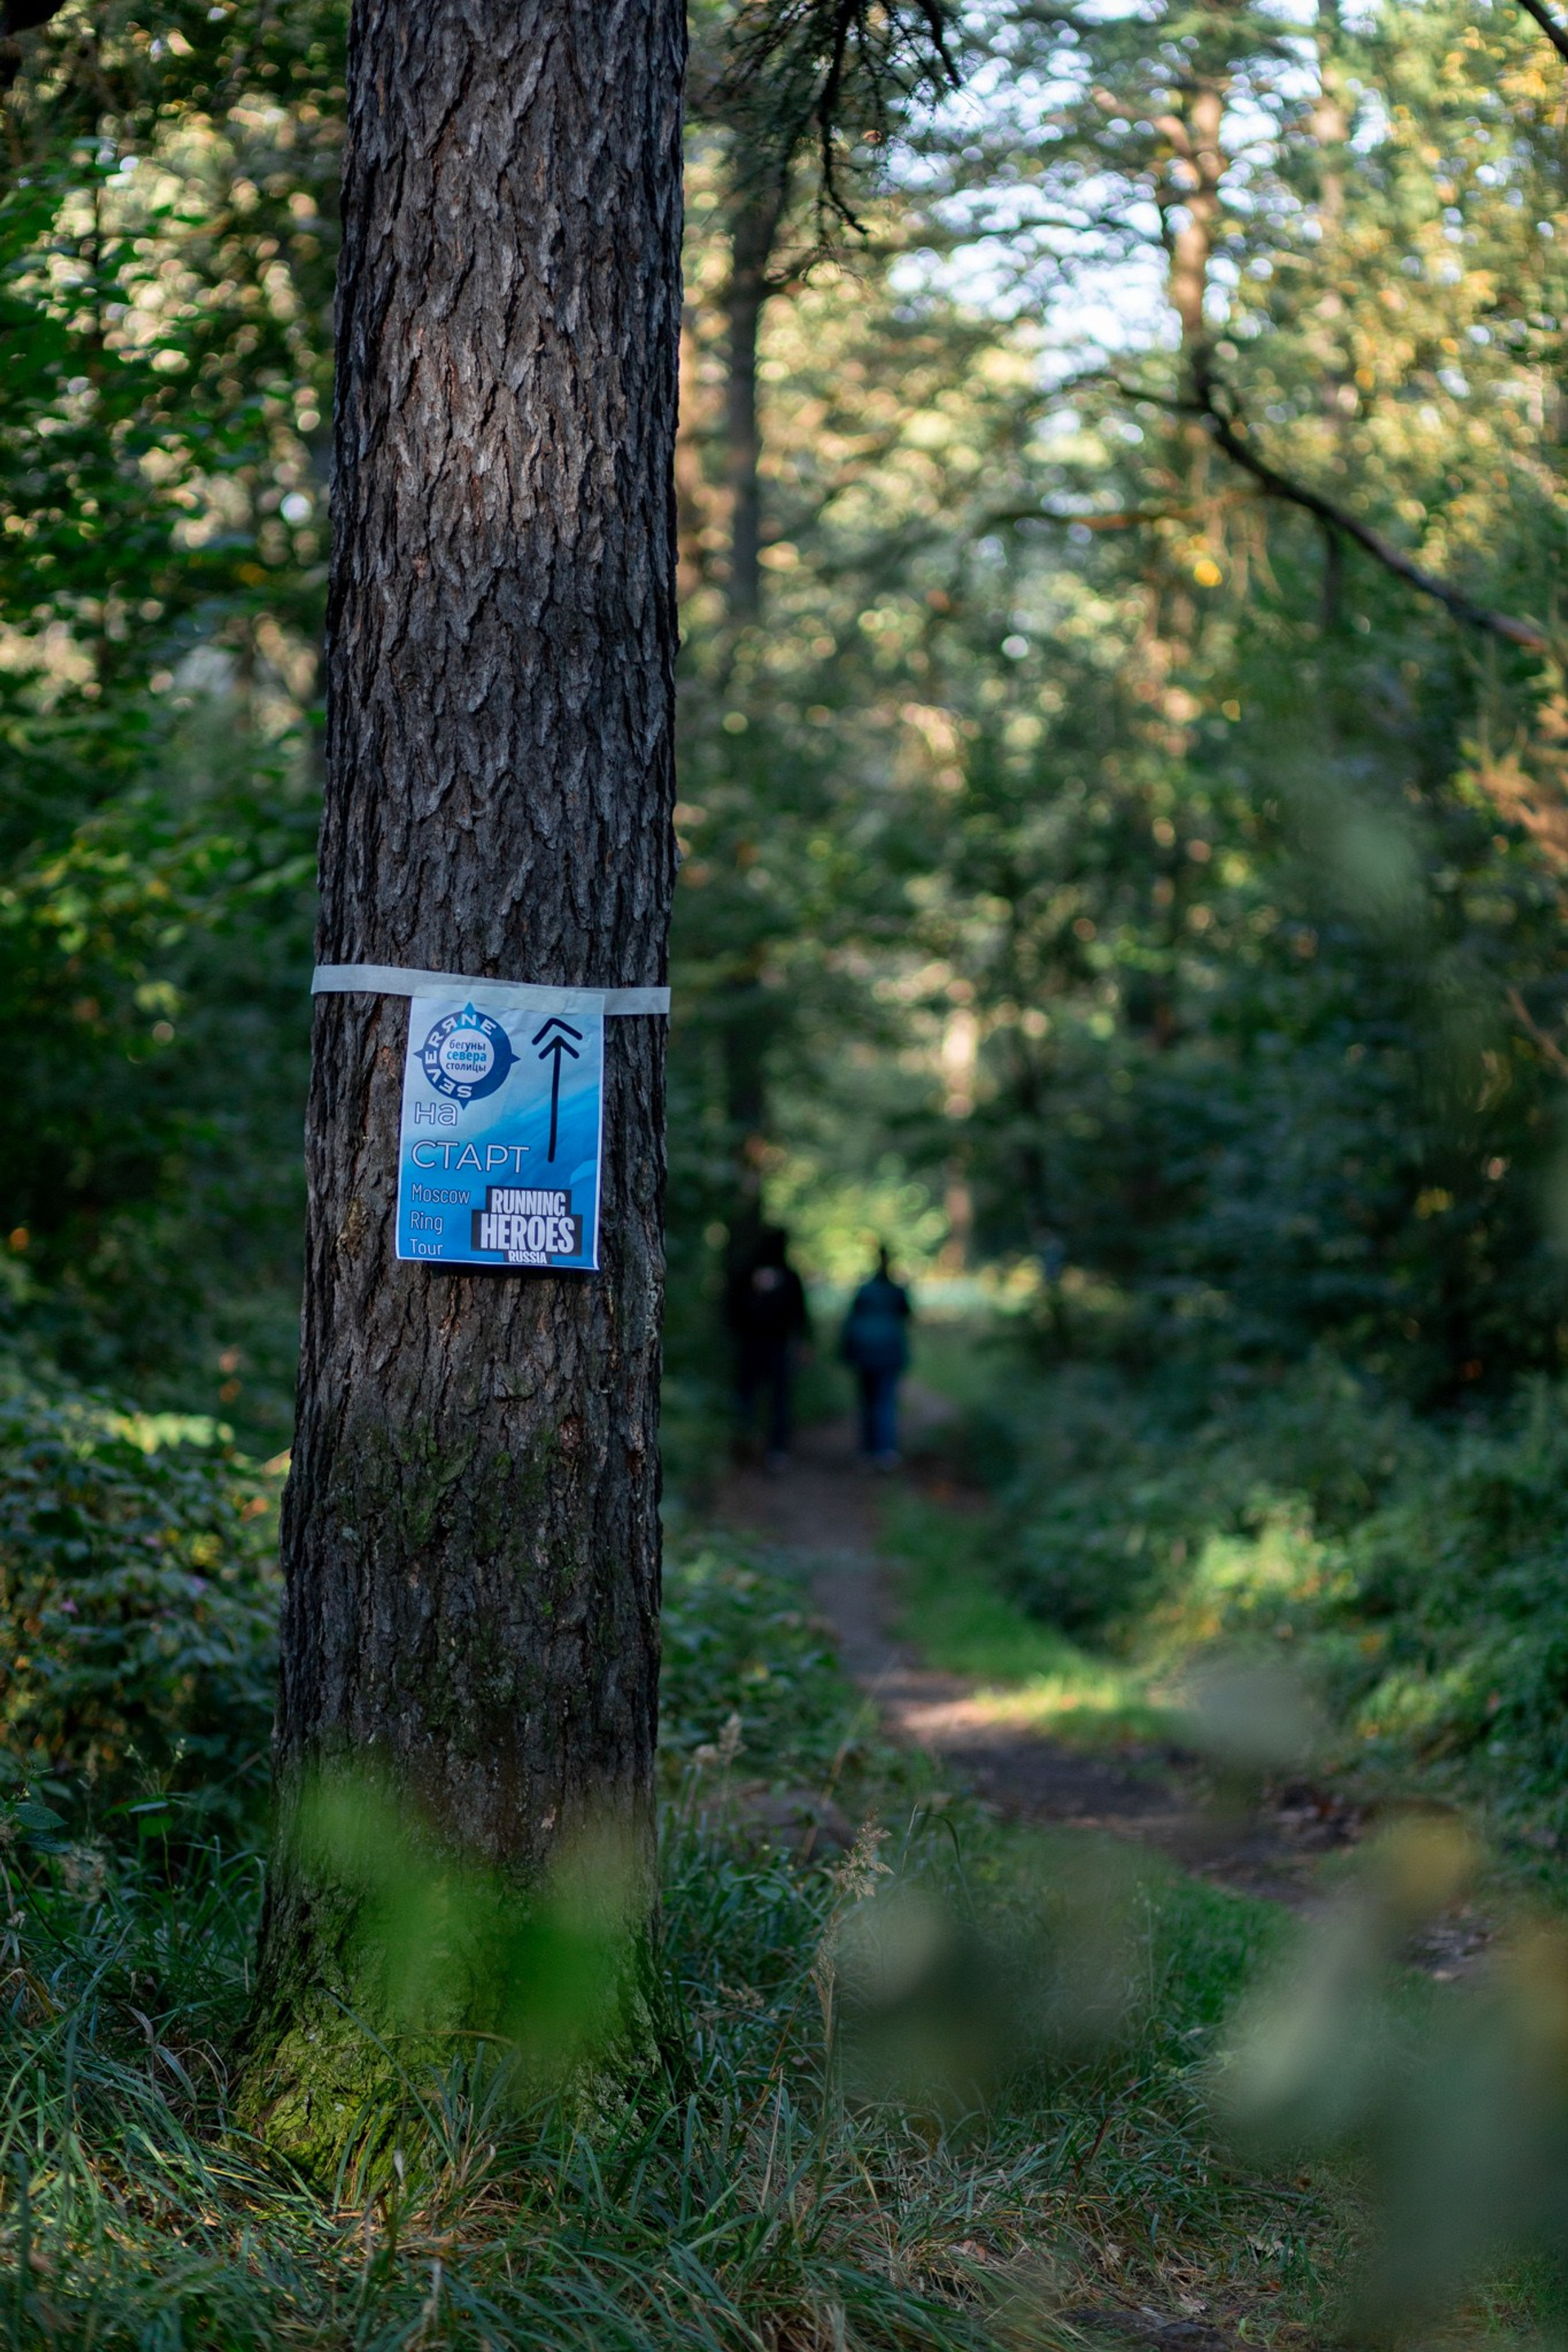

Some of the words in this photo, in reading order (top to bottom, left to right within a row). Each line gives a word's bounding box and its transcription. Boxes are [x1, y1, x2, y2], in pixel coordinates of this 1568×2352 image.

[449, 1039, 486, 1052] бегуны
[445, 1062, 486, 1073] столицы
[447, 1051, 487, 1065] севера
[412, 1139, 530, 1174] СТАРТ
[412, 1183, 470, 1205] Moscow
[491, 1188, 567, 1217] RUNNING
[411, 1210, 443, 1236] Ring
[480, 1214, 575, 1254] HEROES
[409, 1238, 443, 1256] Tour
[508, 1250, 547, 1264] RUSSIA
